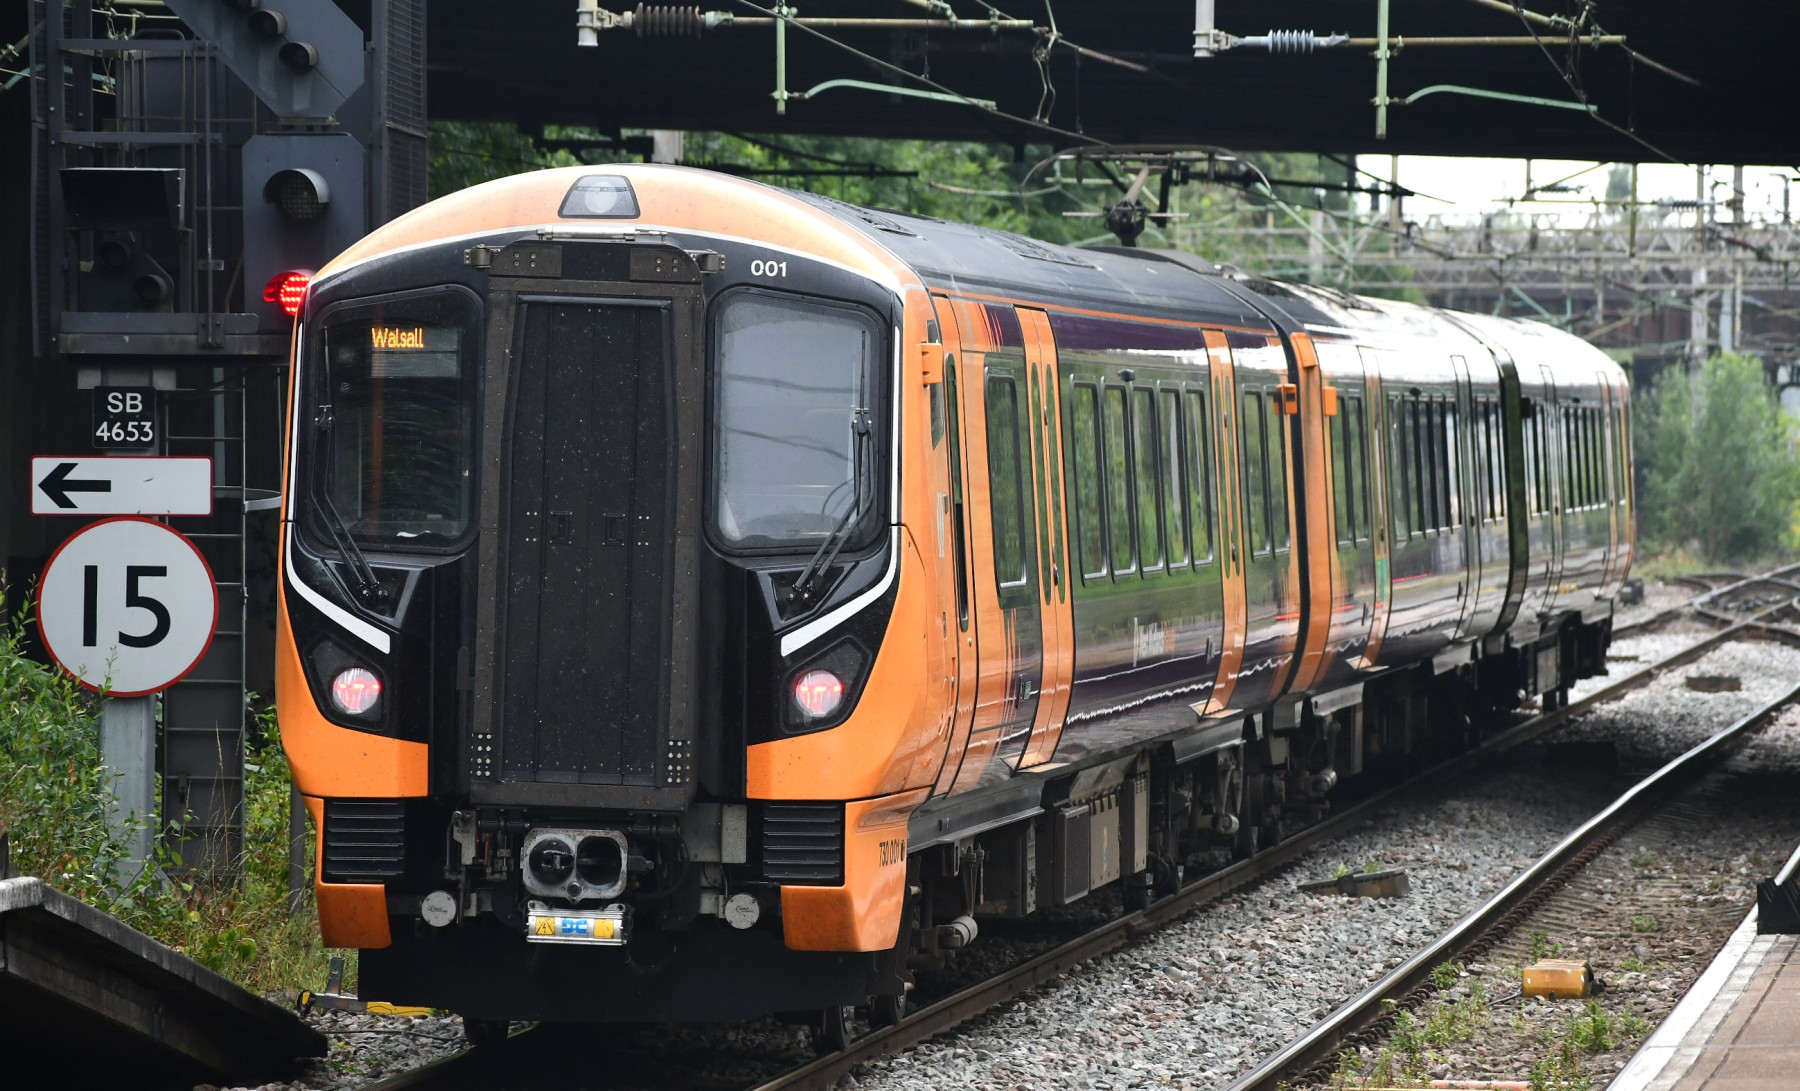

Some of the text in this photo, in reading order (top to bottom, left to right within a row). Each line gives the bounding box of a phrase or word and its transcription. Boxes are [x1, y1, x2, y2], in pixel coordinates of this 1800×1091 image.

[750, 259, 787, 278] 001
[371, 327, 424, 348] Walsall
[106, 391, 143, 413] SB
[95, 421, 154, 442] 4653
[83, 564, 171, 648] 15
